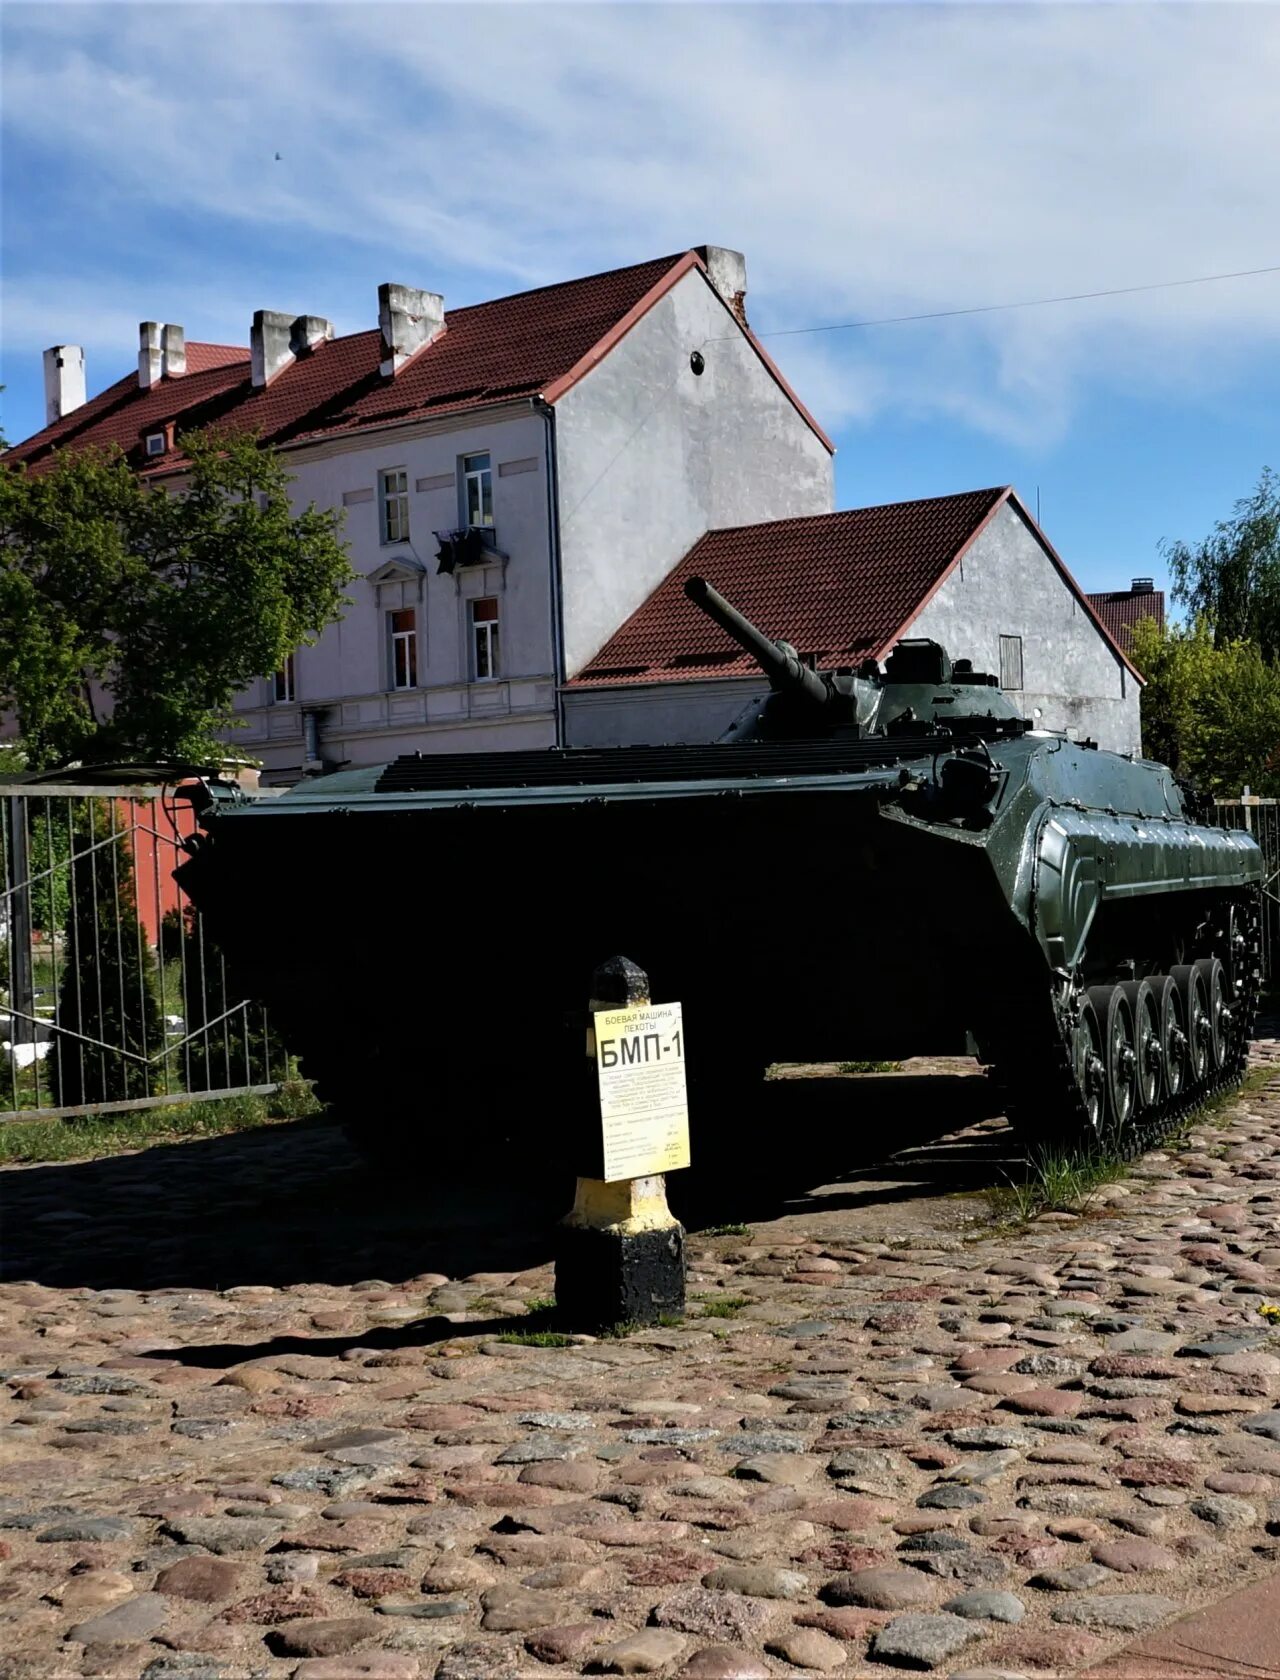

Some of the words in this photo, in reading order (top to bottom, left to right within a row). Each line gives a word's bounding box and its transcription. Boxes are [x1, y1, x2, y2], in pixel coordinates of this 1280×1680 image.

[605, 1014, 637, 1025] БОЕВАЯ
[639, 1009, 673, 1020] МАШИНА
[624, 1022, 657, 1033] ПЕХОТЫ
[600, 1030, 681, 1068] БМП-1
